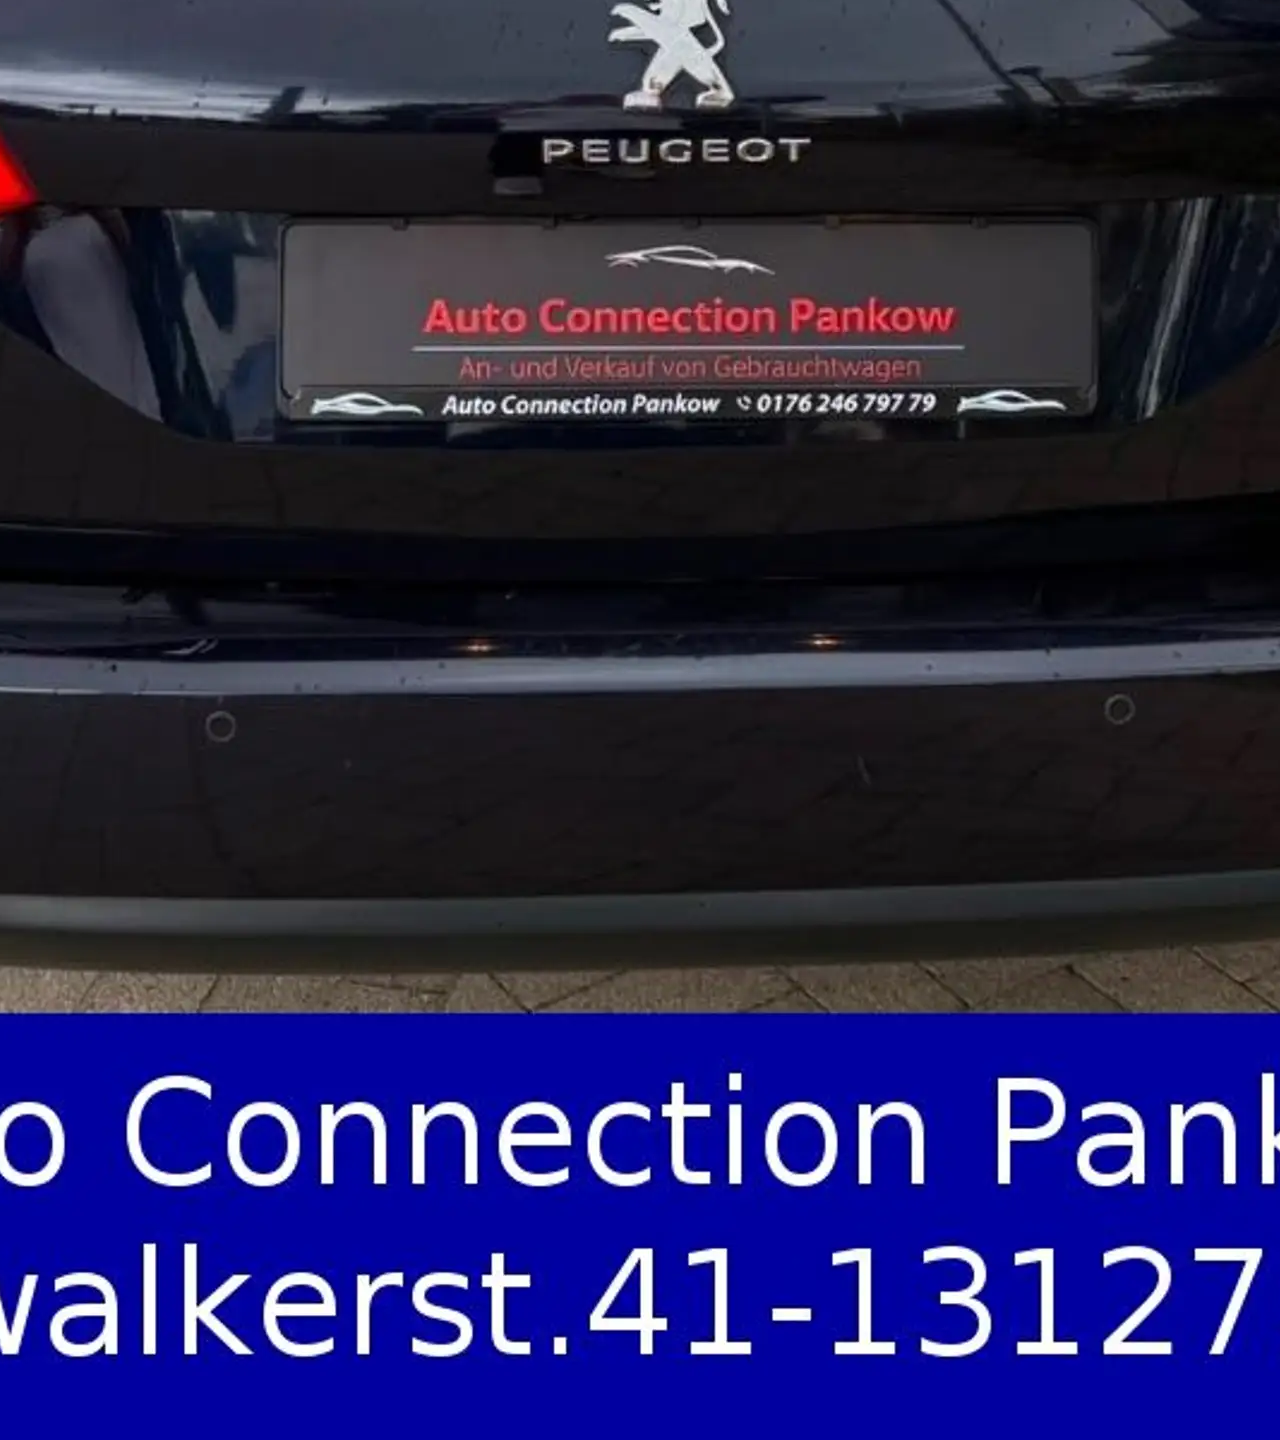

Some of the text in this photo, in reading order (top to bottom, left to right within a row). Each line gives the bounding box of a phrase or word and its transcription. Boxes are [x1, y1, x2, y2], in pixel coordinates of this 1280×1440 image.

[542, 136, 812, 163] PEUGEOT
[423, 296, 956, 335] Auto Connection Pankow
[510, 355, 558, 380] und
[564, 355, 659, 380] Verkauf
[662, 361, 707, 380] von
[712, 354, 922, 384] Gebrauchtwagen
[441, 392, 938, 418] Auto Connection Pankow 0176 246 797 79
